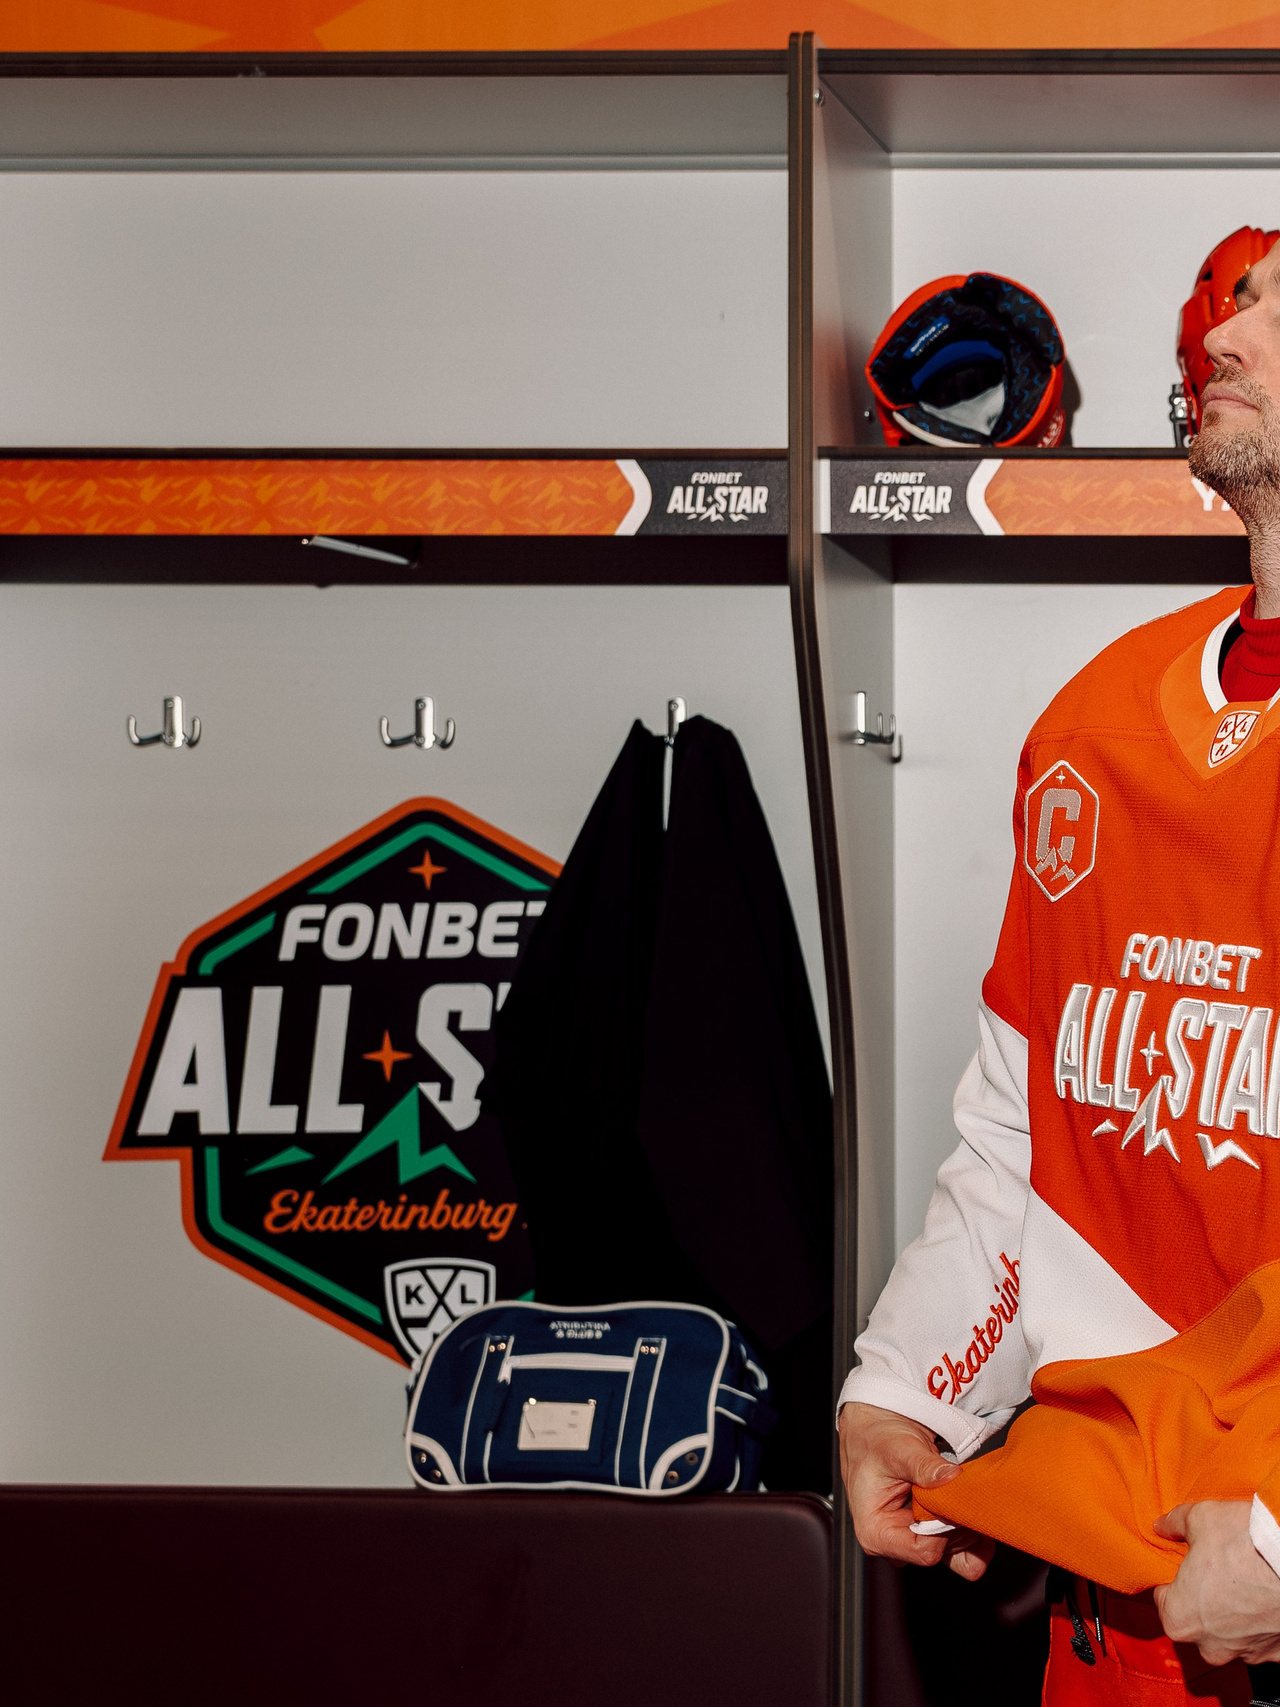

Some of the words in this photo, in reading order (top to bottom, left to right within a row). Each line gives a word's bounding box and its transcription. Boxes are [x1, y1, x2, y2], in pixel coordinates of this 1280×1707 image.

[691, 472, 742, 485] FONBET
[874, 472, 926, 485] FONBET
[666, 486, 708, 514] ALL
[716, 486, 769, 515] STAR
[849, 486, 890, 514] ALL
[898, 486, 953, 515] STAR
[1120, 933, 1262, 993] FONBET
[137, 984, 365, 1136] ALL
[1054, 983, 1147, 1112] ALL
[263, 1189, 518, 1242] Ekaterinburg
